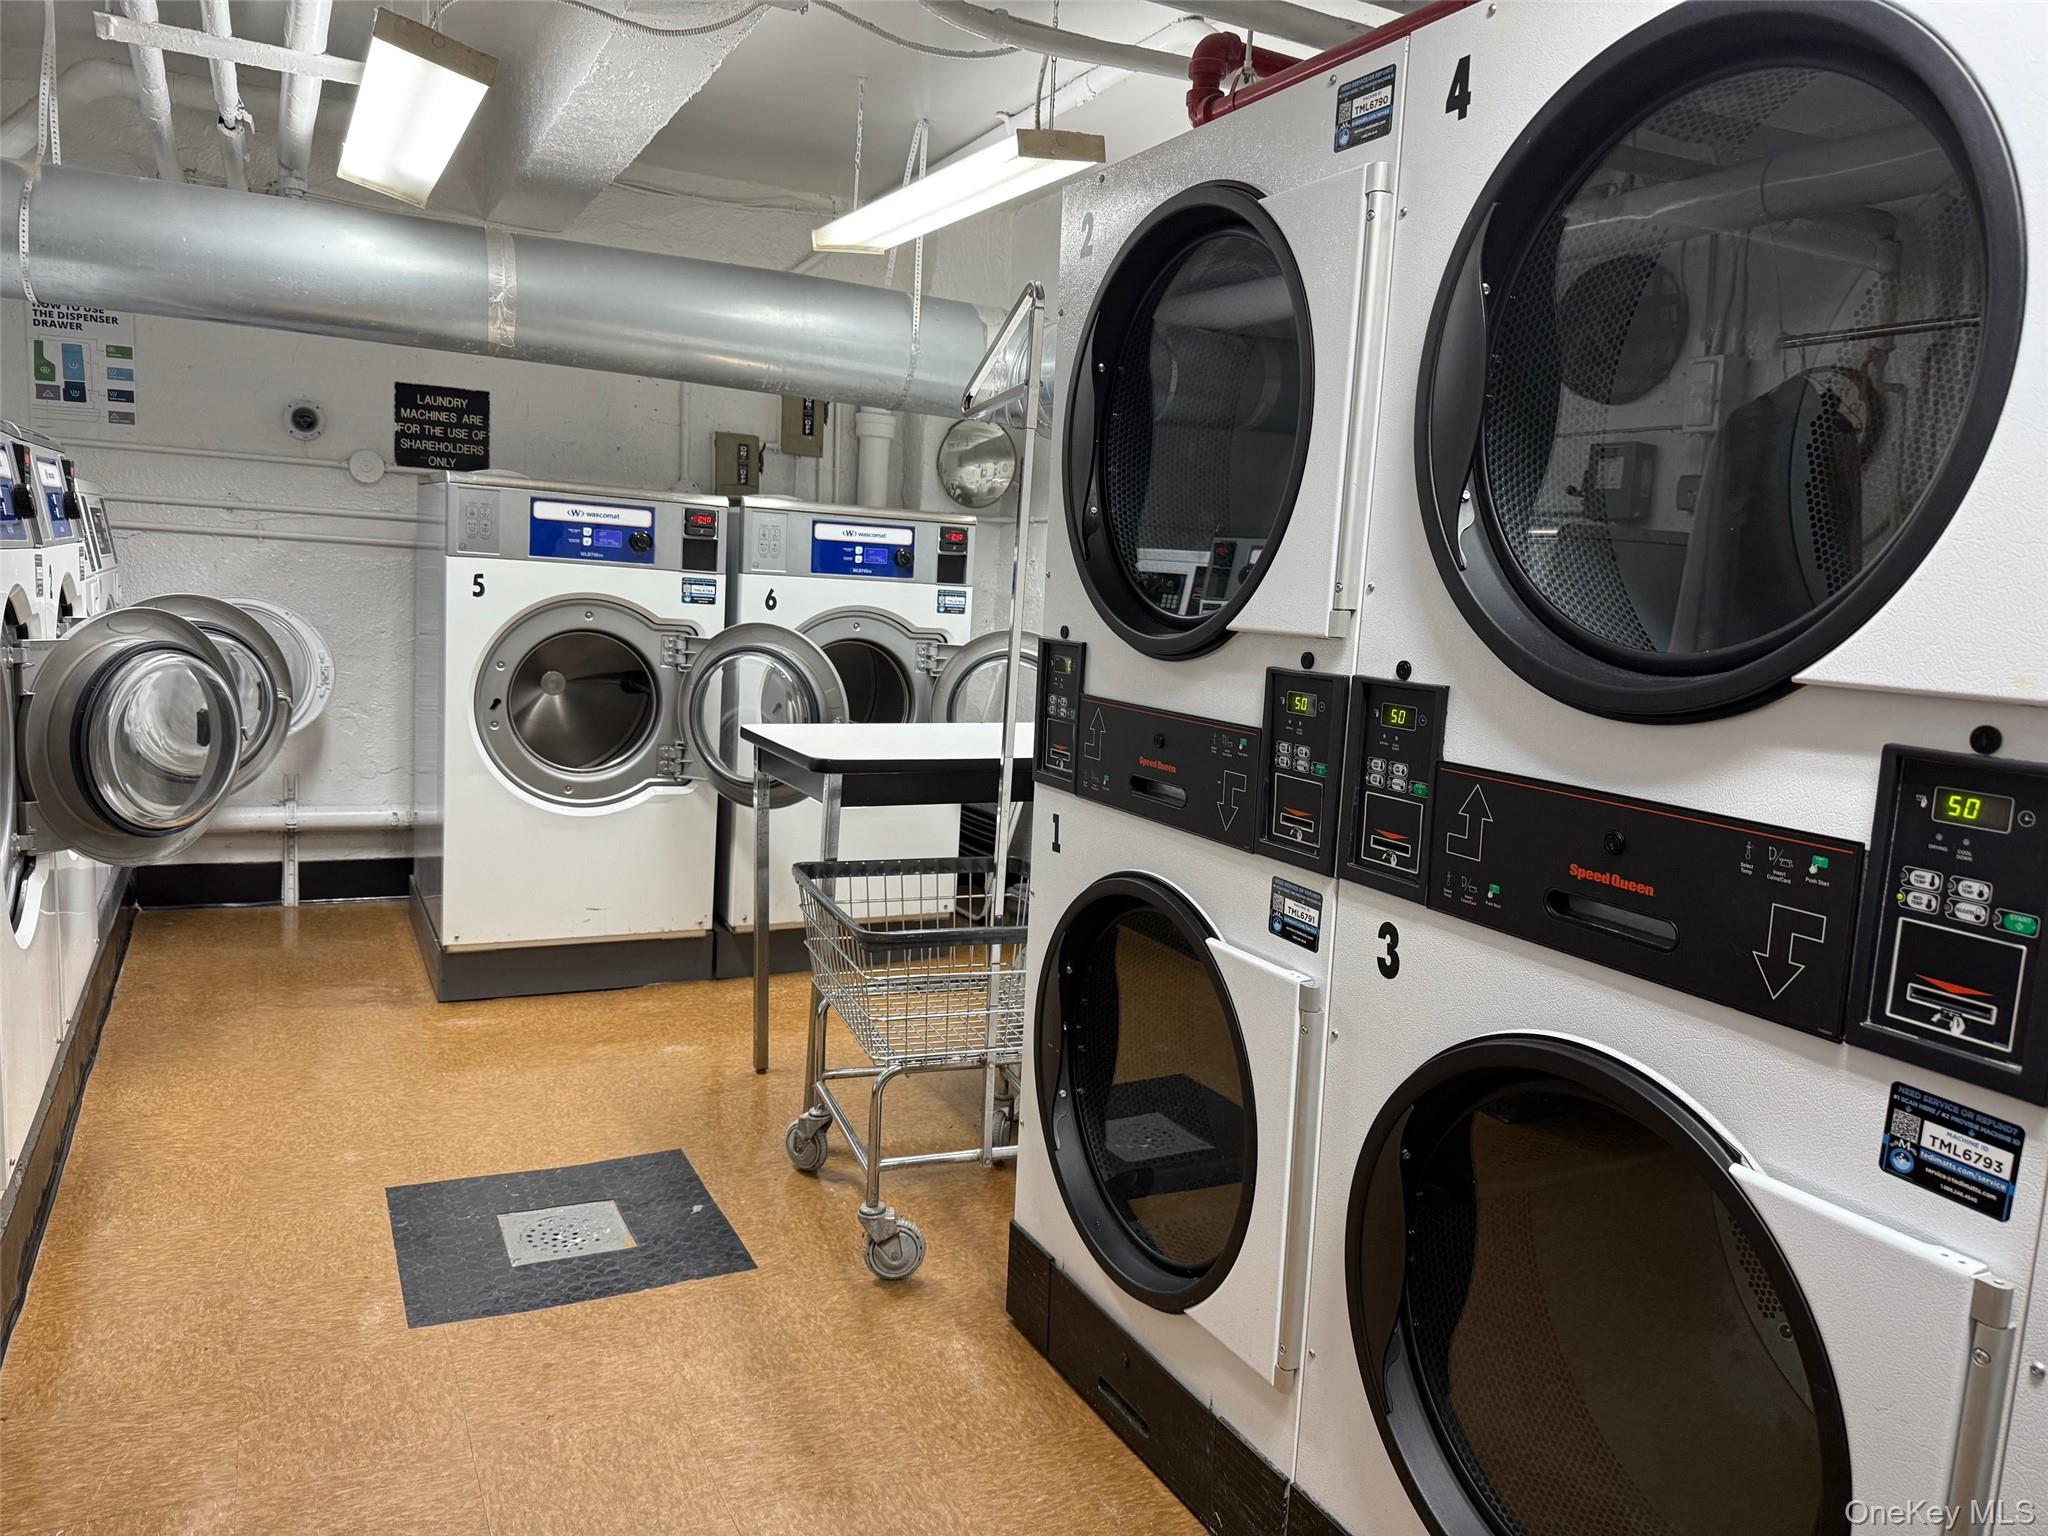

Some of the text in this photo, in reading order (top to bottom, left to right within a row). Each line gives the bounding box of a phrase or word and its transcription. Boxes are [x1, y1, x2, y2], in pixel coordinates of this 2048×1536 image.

[1445, 54, 1471, 121] 4
[1080, 212, 1094, 258] 2
[32, 308, 119, 325] THE DISPENSER
[33, 318, 83, 331] DRAWER
[417, 394, 468, 408] LAUNDRY
[400, 408, 484, 426] MACHINES ARE
[398, 423, 487, 440] FOR THE USE OF
[400, 438, 485, 456] SHAREHOLDERS
[428, 456, 457, 468] ONLY
[472, 573, 485, 597] 5
[764, 588, 777, 611] 6
[1295, 696, 1308, 710] 50
[1391, 709, 1406, 724] 50
[1139, 755, 1158, 768] Speed
[1948, 795, 1980, 819] 50
[1052, 813, 1061, 854] 1
[1569, 863, 1655, 897] Speed Queen
[1377, 921, 1400, 980] 3
[1923, 1094, 1960, 1114] SERVICE
[1960, 1109, 1975, 1120] OR
[1975, 1113, 2019, 1136] REFUND?
[1946, 1131, 1989, 1152] MACHINE ID
[1929, 1134, 2004, 1174] TML6793
[1920, 1151, 2007, 1192] tedimatts.com/service
